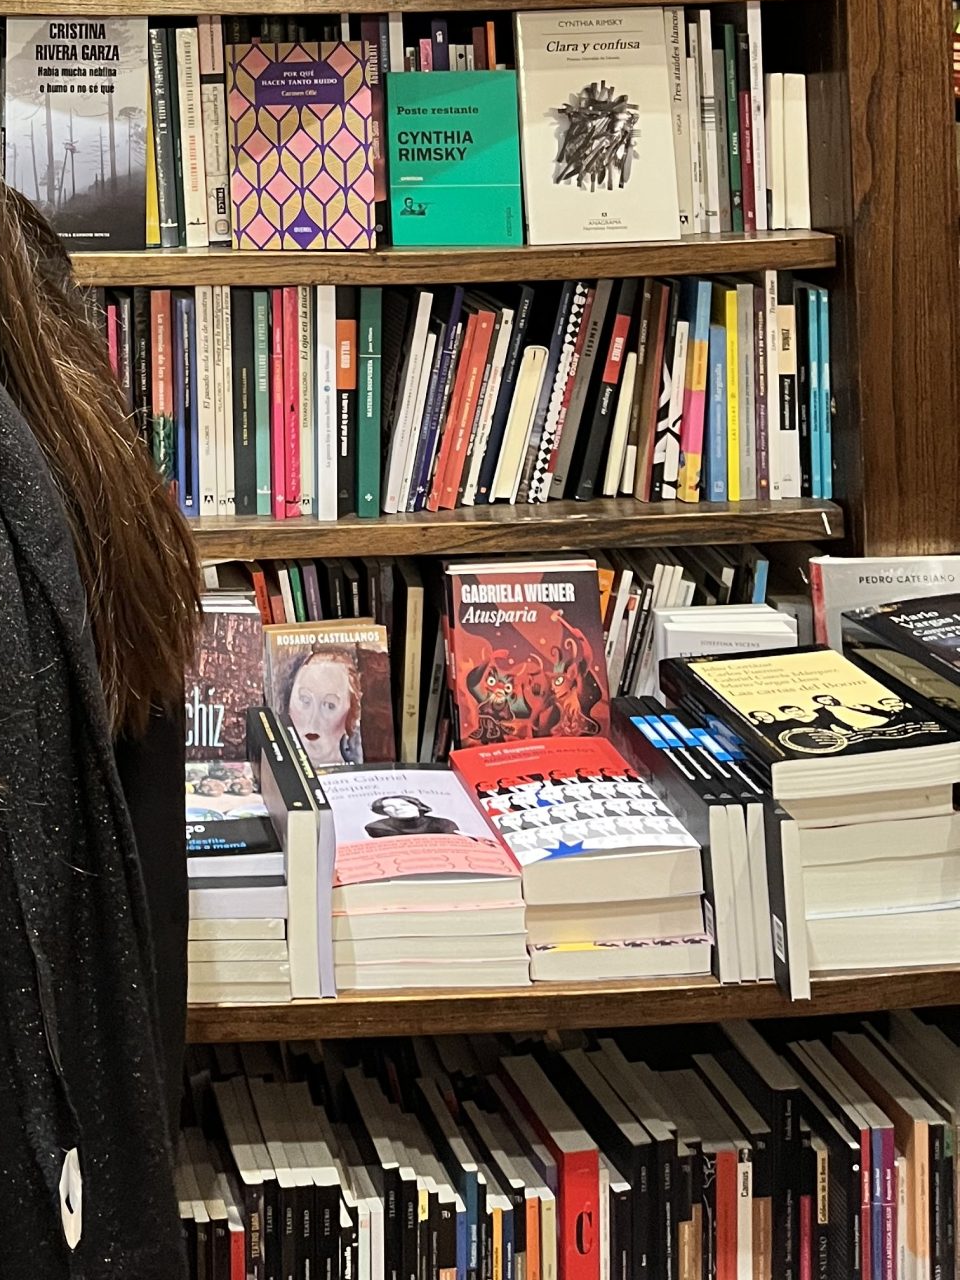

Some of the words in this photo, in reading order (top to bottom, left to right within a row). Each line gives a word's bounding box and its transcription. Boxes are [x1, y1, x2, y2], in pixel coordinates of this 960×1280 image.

[558, 19, 594, 28] CYNTHIA
[595, 18, 623, 27] RIMSKY
[670, 10, 679, 44] blancos
[49, 22, 106, 40] CRISTINA
[35, 45, 78, 61] RIVERA
[81, 44, 119, 61] GARZA
[546, 40, 579, 53] Clara
[582, 43, 590, 55] y
[593, 39, 640, 54] confusa
[671, 46, 680, 81] ataúdes
[38, 66, 59, 77] Había
[61, 66, 87, 77] mucha
[89, 66, 117, 77] neblina
[300, 69, 315, 78] QUÉ
[39, 85, 45, 93] o
[47, 83, 68, 94] humo
[70, 85, 75, 93] o
[77, 85, 87, 93] no
[288, 78, 312, 86] TANTO
[673, 83, 682, 102] Tres
[397, 105, 428, 115] Poste
[431, 105, 479, 115] restante
[397, 130, 474, 145] CYNTHIA
[398, 147, 467, 162] RIMSKY
[299, 287, 308, 309] nuca
[299, 310, 308, 318] la
[520, 299, 529, 318] VITALE
[157, 313, 164, 323] La
[200, 325, 208, 335] de
[300, 320, 308, 334] en
[157, 325, 165, 353] tiranía
[300, 335, 309, 348] ojo
[300, 350, 309, 360] El
[611, 337, 624, 362] WIENER
[157, 355, 165, 364] de
[157, 366, 165, 378] las
[202, 374, 212, 400] pasado
[714, 363, 723, 402] Marginalia
[157, 380, 165, 410] moscas
[601, 386, 613, 415] Atusparia
[202, 401, 210, 409] El
[858, 575, 893, 584] PEDRO
[896, 574, 955, 583] CATERIANO
[461, 583, 524, 604] GABRIELA
[525, 582, 575, 603] WIENER
[461, 606, 537, 627] Atusparia
[889, 609, 939, 624] Mario
[899, 617, 954, 631] Vargas
[277, 633, 316, 646] ROSARIO
[318, 631, 380, 644] CASTELLANOS
[700, 640, 733, 648] JOSEFINA
[734, 641, 760, 649] VICENS
[701, 663, 725, 672] Julio
[727, 662, 773, 671] Cortázar
[708, 669, 741, 678] Carlos
[742, 667, 784, 676] Fuentes
[714, 675, 754, 684] Gabriel
[755, 672, 789, 682] García
[792, 668, 839, 679] Márquez
[720, 681, 754, 690] Mario
[756, 679, 788, 689] Vargas
[791, 676, 820, 685] Llosa
[729, 688, 749, 697] Las
[756, 686, 793, 696] cartas
[800, 683, 822, 693] del
[823, 679, 868, 691] Boom
[503, 745, 545, 756] Supremo
[322, 777, 349, 786] uan
[354, 774, 407, 785] Gabriel
[353, 791, 398, 800] nombres
[740, 1171, 748, 1197] Camus
